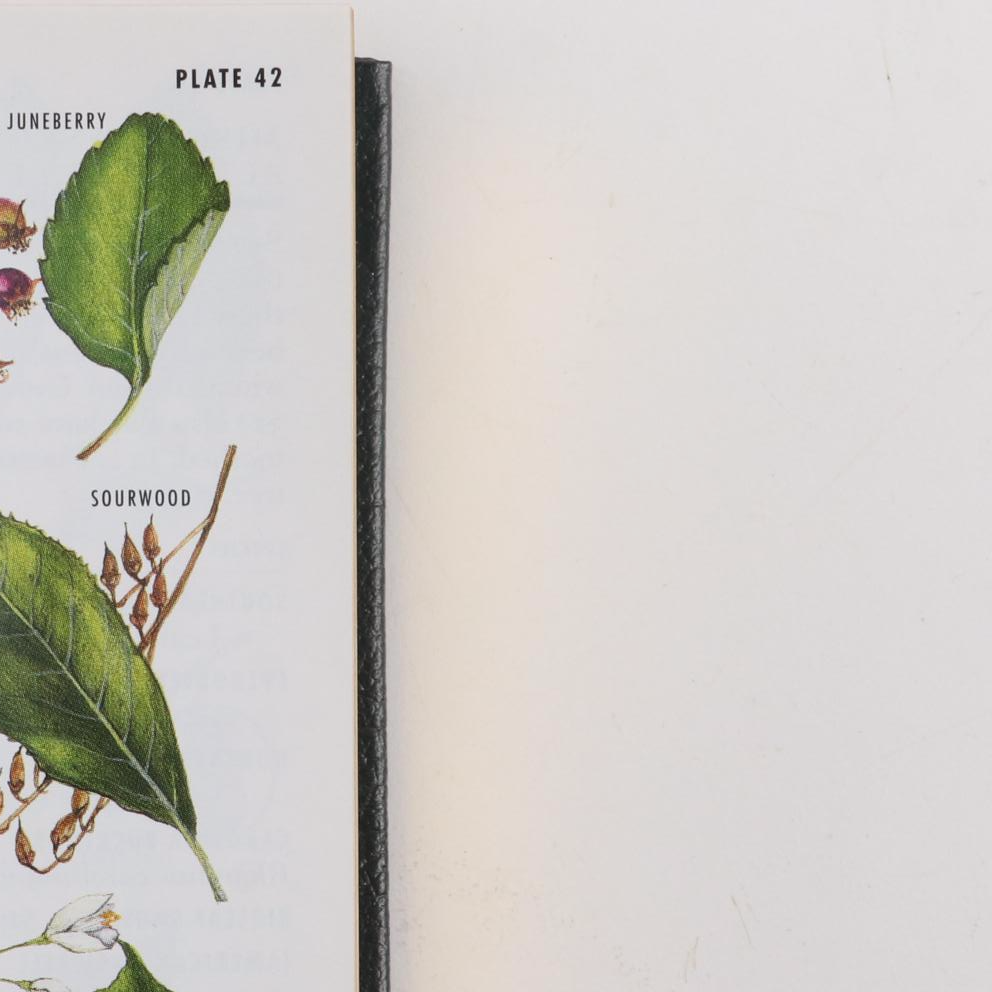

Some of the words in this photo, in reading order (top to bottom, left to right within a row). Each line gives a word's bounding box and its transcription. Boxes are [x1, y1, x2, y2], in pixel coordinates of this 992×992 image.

[175, 68, 242, 89] PLATE
[254, 67, 282, 88] 42
[7, 111, 107, 130] JUNEBERRY
[90, 489, 191, 508] SOURWOOD
